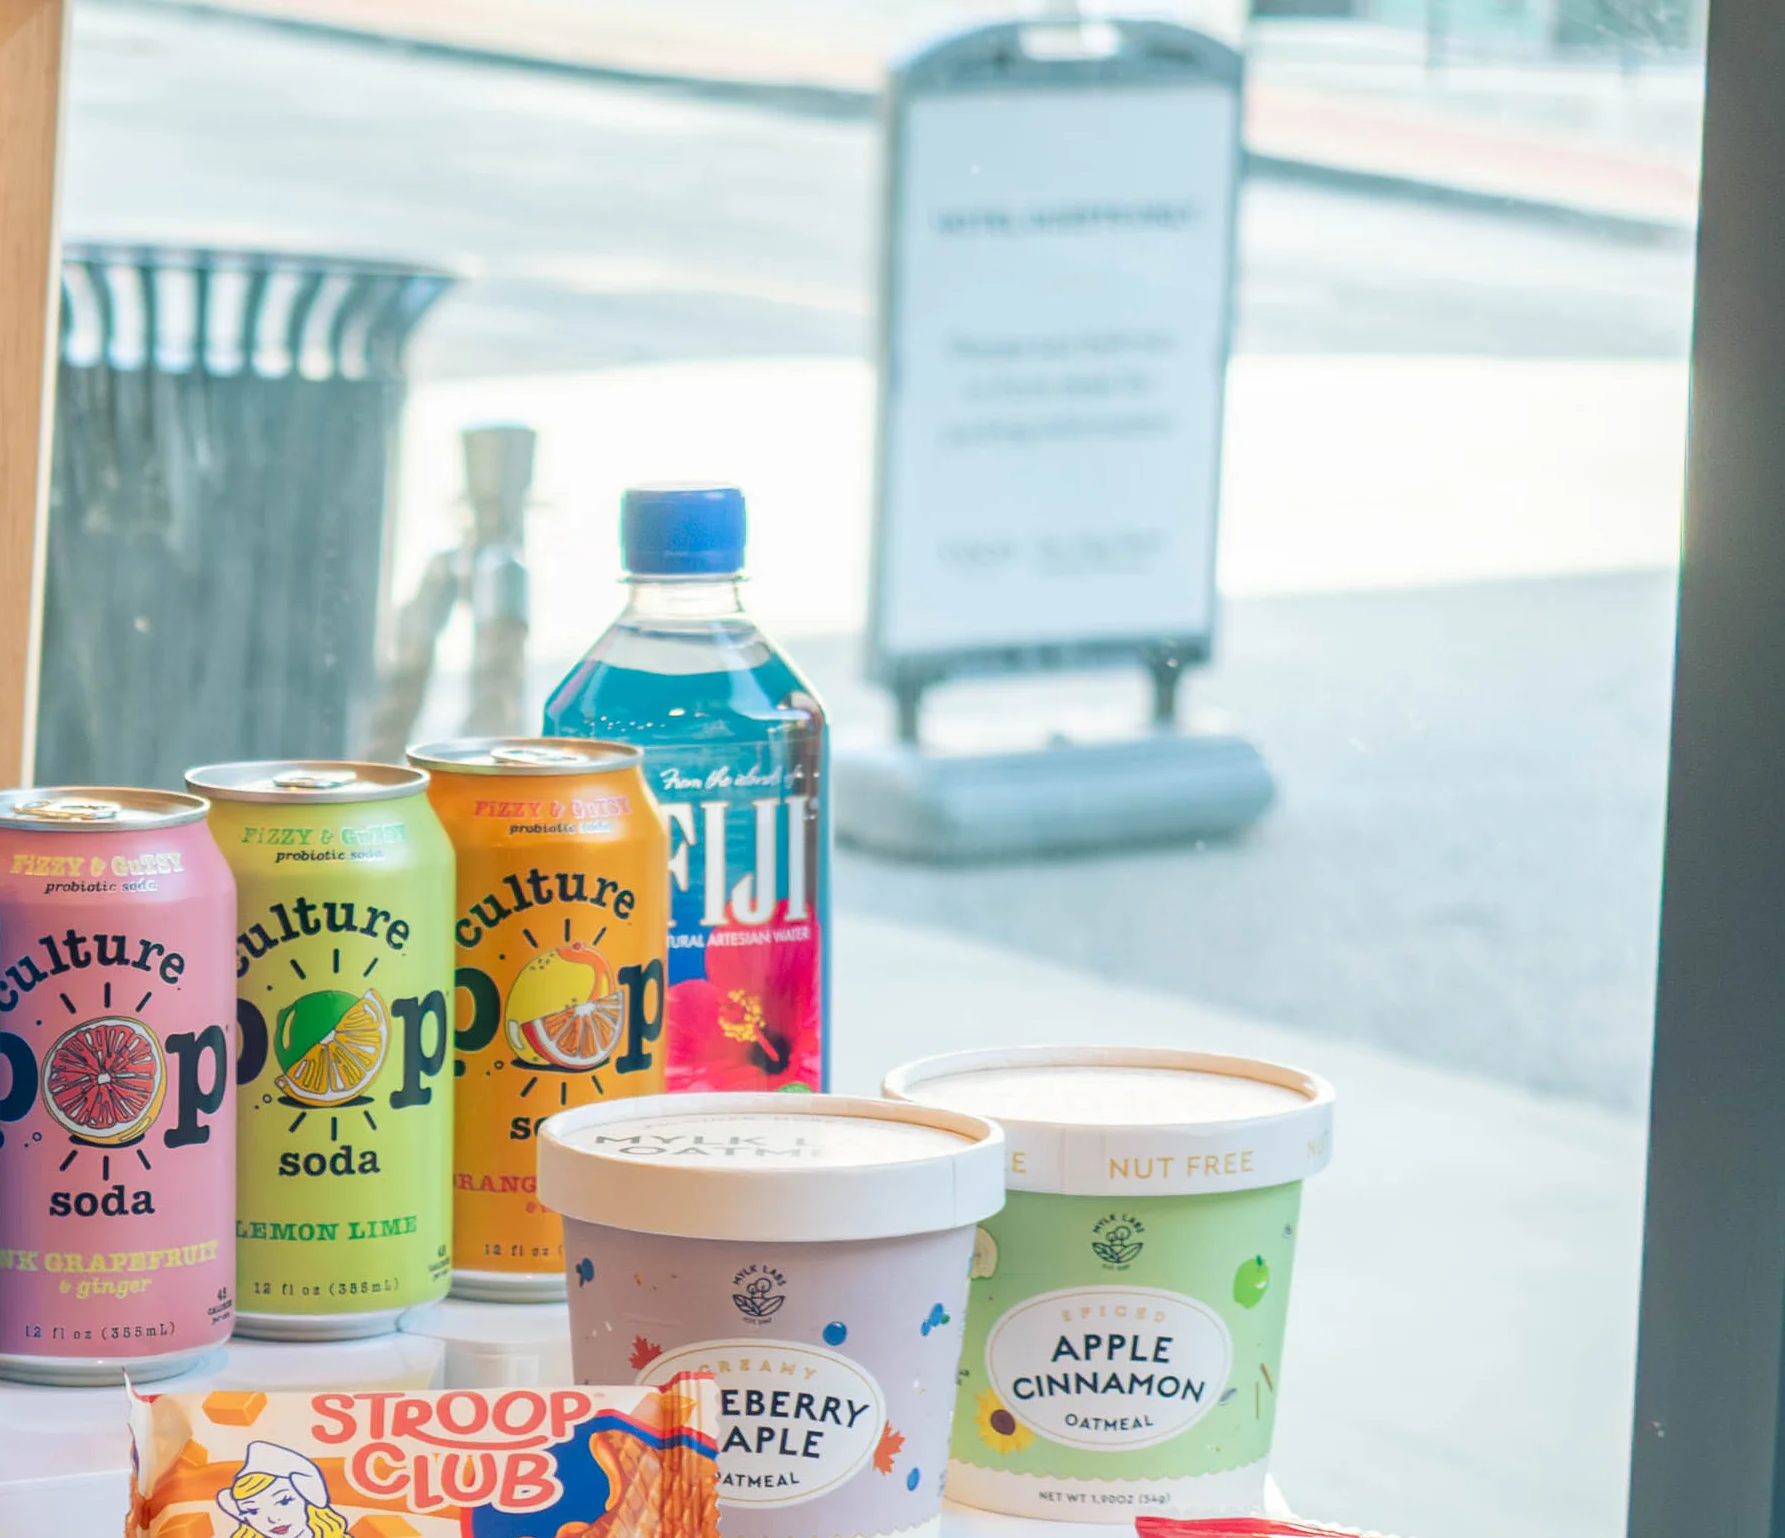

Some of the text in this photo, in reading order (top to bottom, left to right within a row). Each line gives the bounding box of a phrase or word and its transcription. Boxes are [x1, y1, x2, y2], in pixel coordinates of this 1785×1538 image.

[509, 822, 575, 835] probiotic
[274, 850, 345, 863] probiotic
[659, 796, 809, 926] FIJI
[44, 881, 116, 894] probiotic
[455, 868, 635, 947] culture
[707, 926, 810, 947] ARTESIAN WATER
[278, 1145, 380, 1176] soda
[1109, 1150, 1254, 1180] NUT FREE
[49, 1185, 154, 1217] soda
[236, 1215, 417, 1241] LEMON LIME
[44, 1239, 219, 1273] GRAPEFRUIT
[76, 1276, 152, 1299] ginger
[1062, 1306, 1166, 1323] SPICED
[25, 1325, 42, 1338] 12
[52, 1324, 65, 1339] fl
[74, 1328, 91, 1339] oz
[1051, 1334, 1173, 1364] APPLE
[1012, 1372, 1205, 1403] CINNAMON
[311, 1390, 592, 1450] STROOP
[721, 1389, 870, 1428] EBERRY
[1064, 1413, 1154, 1431] OATMEAL
[722, 1425, 824, 1459] APLE
[351, 1442, 555, 1509] CLUB
[716, 1471, 800, 1488] ATMEAL
[1039, 1491, 1062, 1502] NET
[1067, 1491, 1086, 1503] WT
